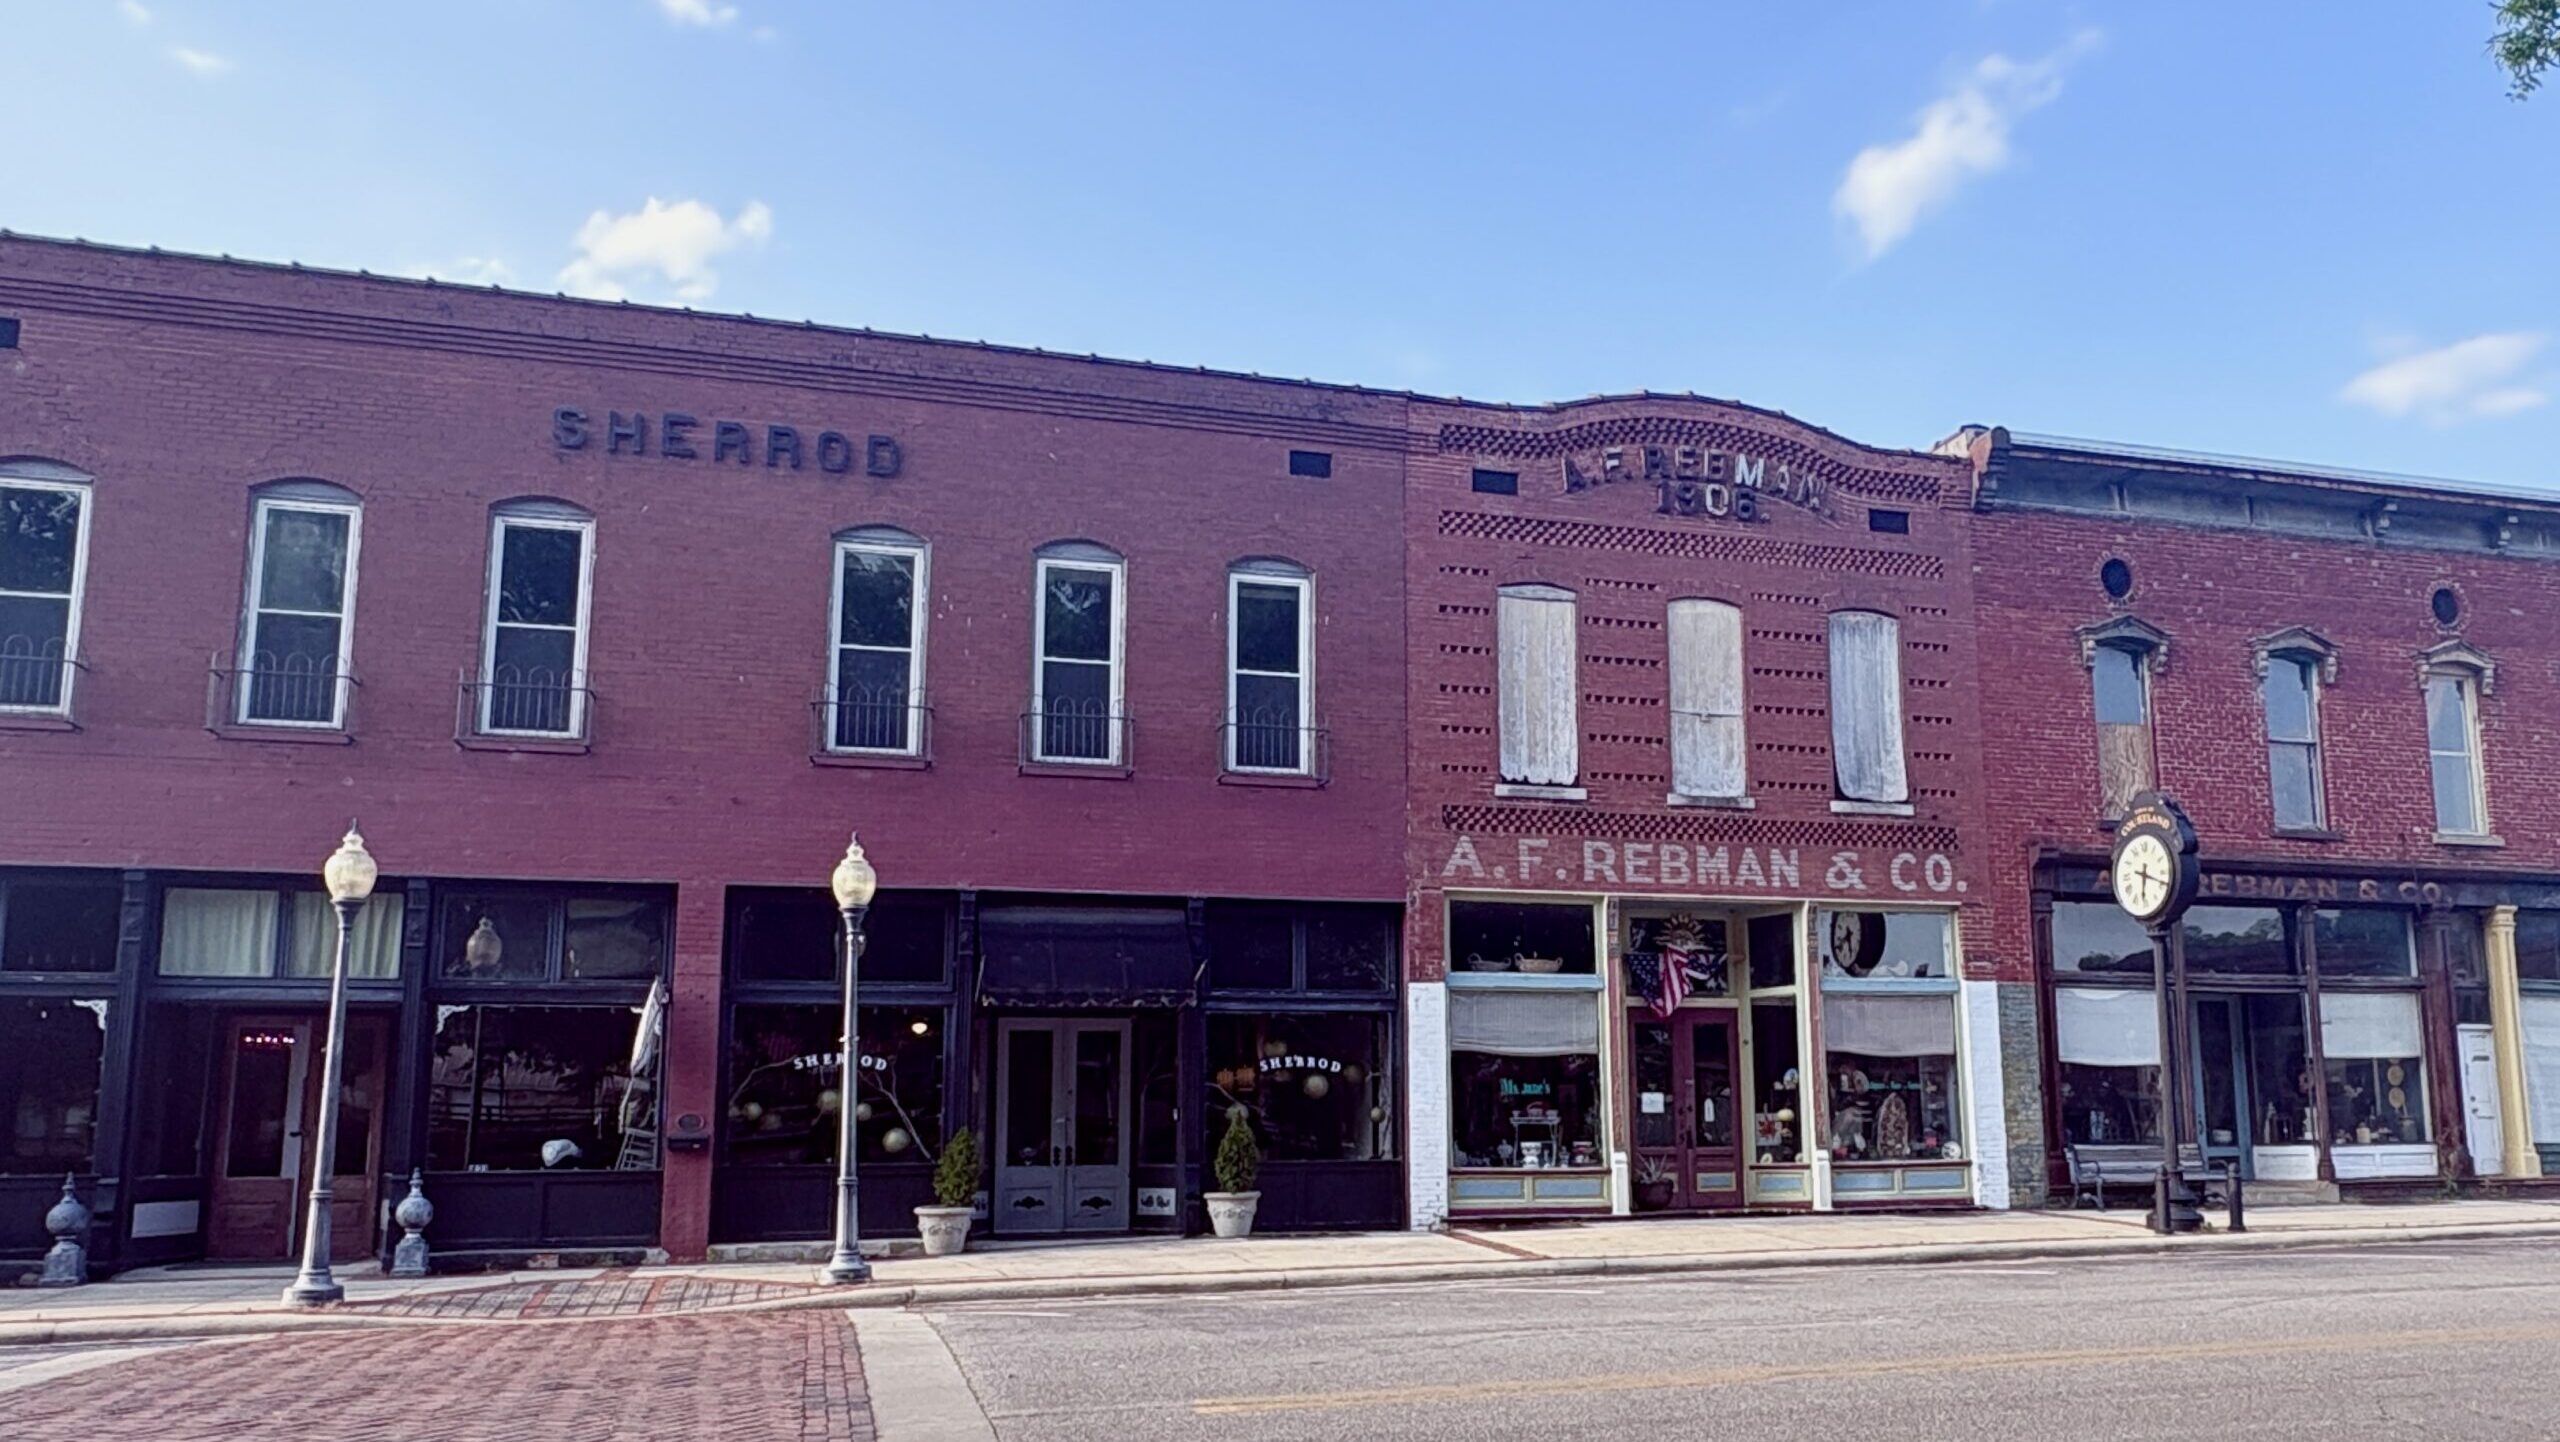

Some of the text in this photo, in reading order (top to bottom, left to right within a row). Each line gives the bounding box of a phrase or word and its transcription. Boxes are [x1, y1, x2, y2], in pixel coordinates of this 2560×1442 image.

[553, 406, 903, 478] SHERROD
[1583, 841, 1800, 888] REBMAN
[1825, 851, 1866, 890] &
[1890, 853, 1968, 892] CO.
[2359, 879, 2378, 900] &
[793, 1052, 887, 1071] SHEROD
[1260, 1055, 1341, 1073] SHERROD
